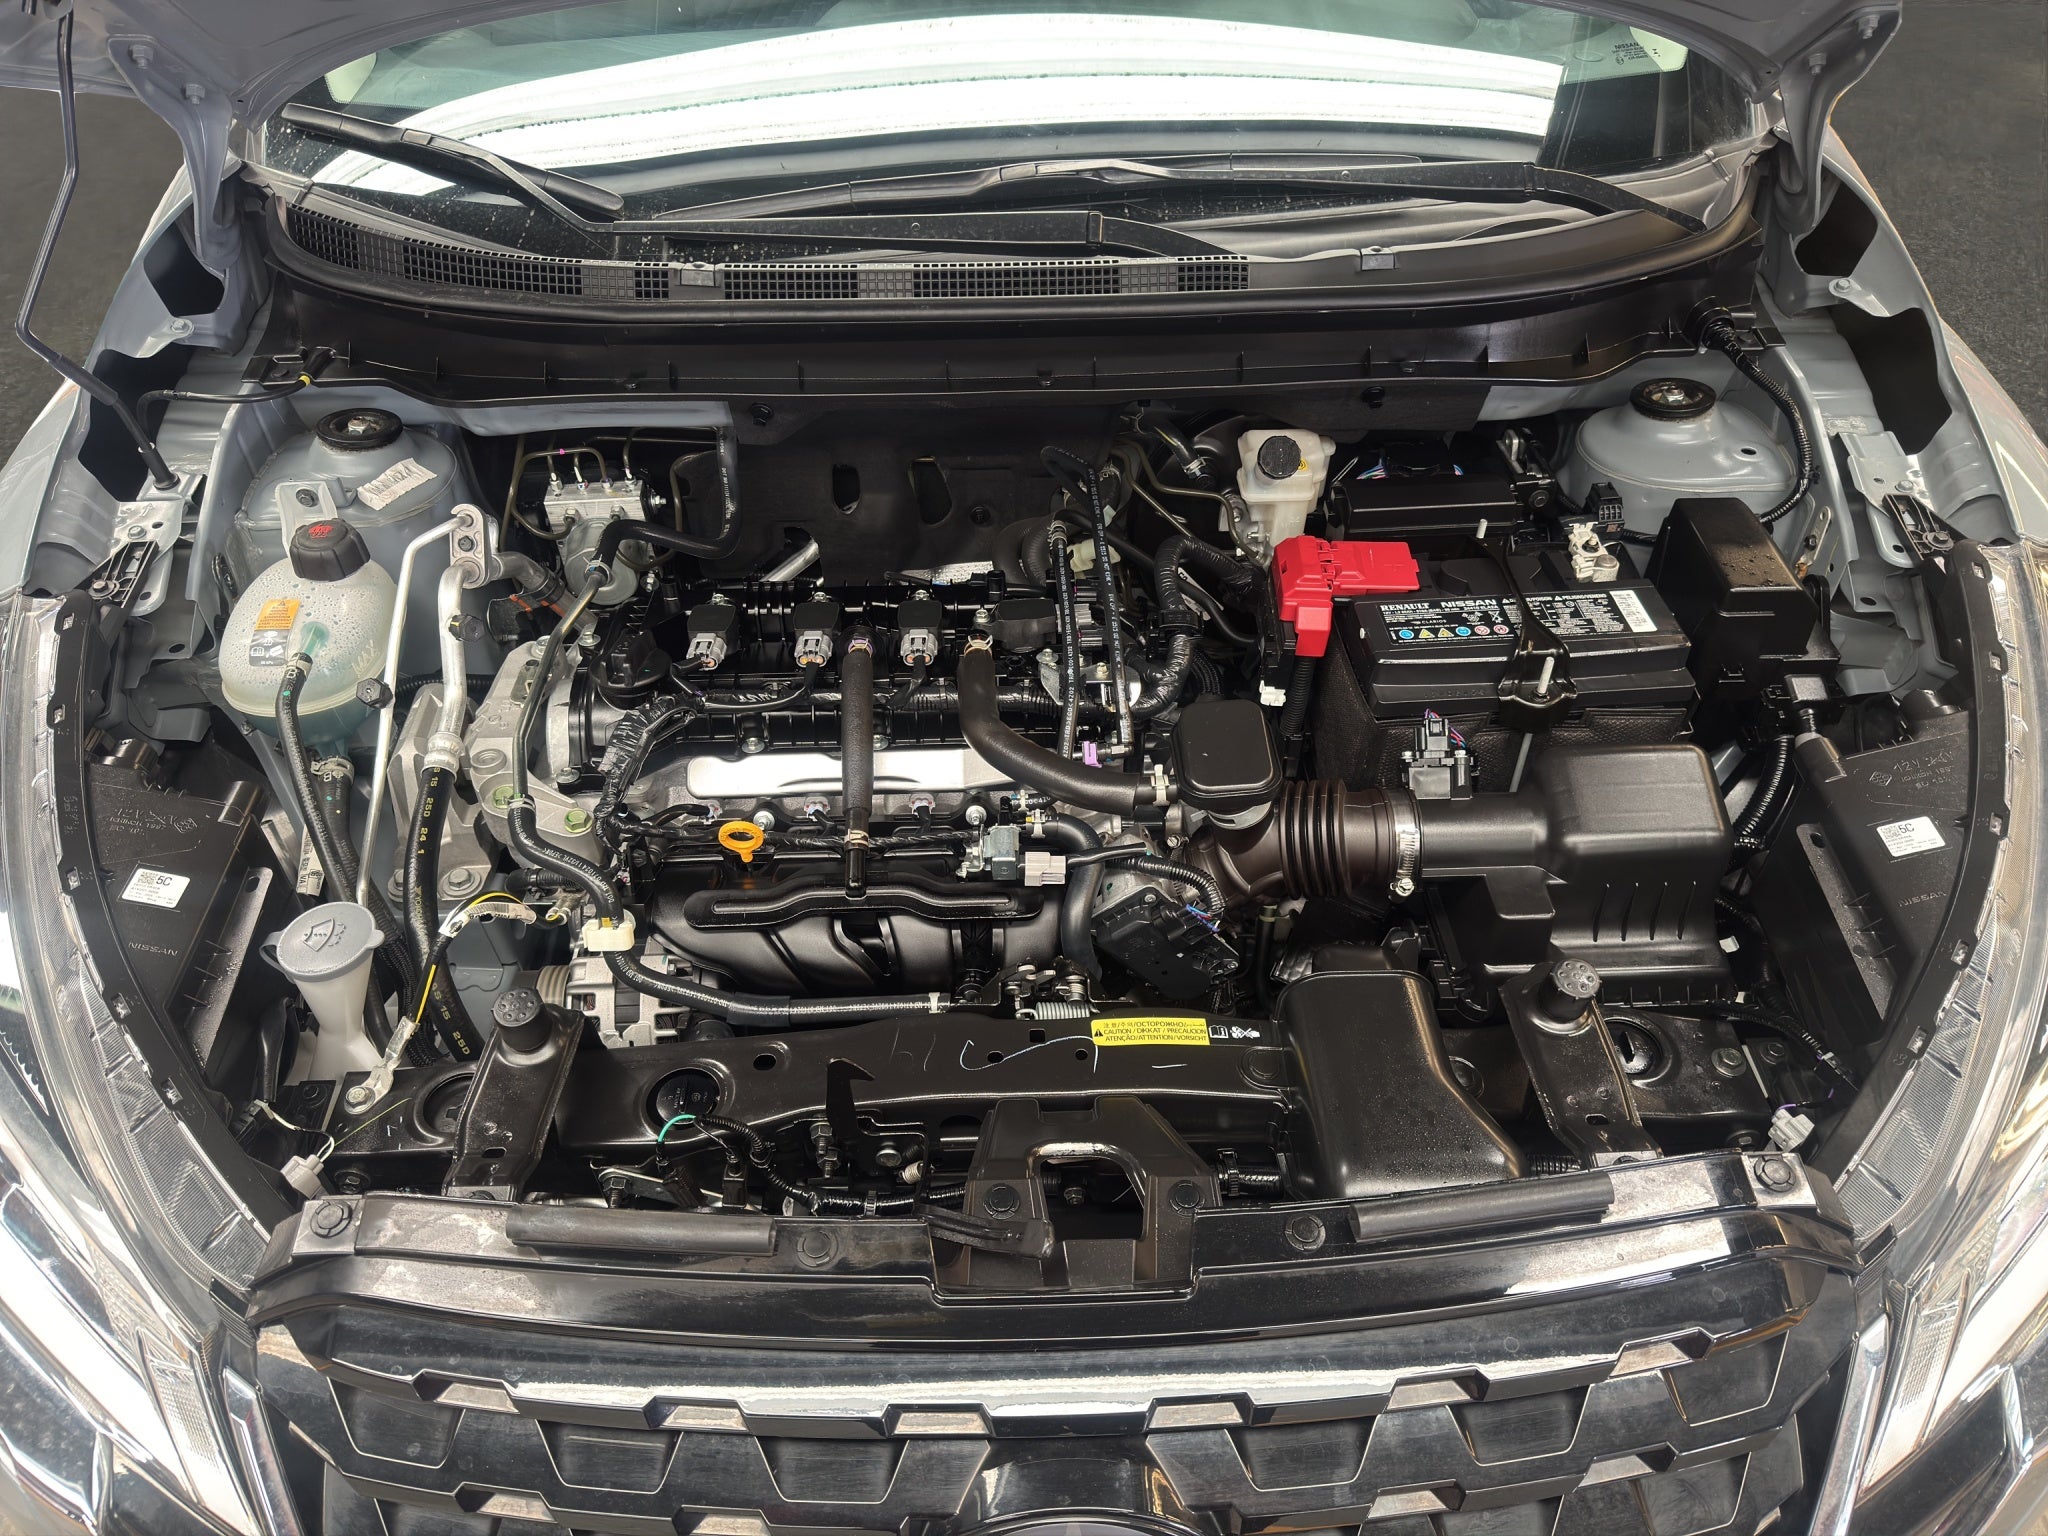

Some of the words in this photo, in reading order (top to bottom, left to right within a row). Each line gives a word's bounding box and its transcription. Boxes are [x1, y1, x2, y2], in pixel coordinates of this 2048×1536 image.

[1380, 602, 1430, 612] RENAULT
[1440, 598, 1497, 609] NISSAN
[420, 827, 428, 841] 24
[1899, 822, 1915, 834] 5C
[156, 875, 173, 887] 5C
[128, 941, 179, 957] NISSAN
[452, 1031, 471, 1056] 25D
